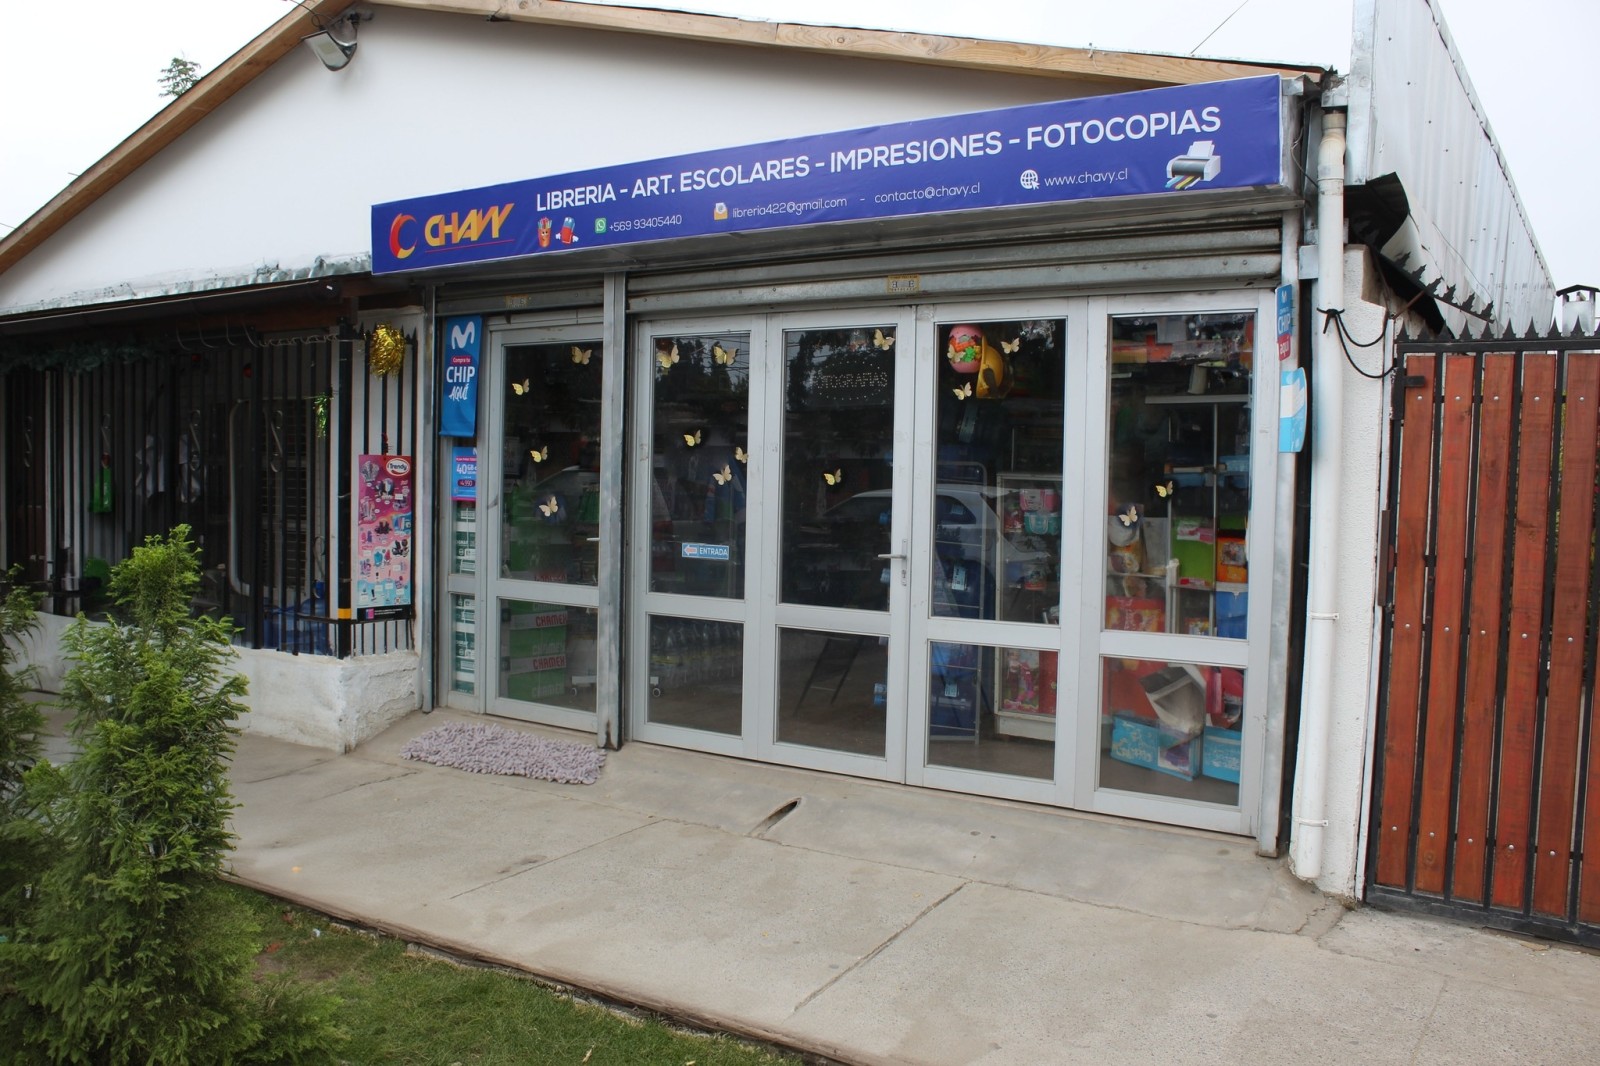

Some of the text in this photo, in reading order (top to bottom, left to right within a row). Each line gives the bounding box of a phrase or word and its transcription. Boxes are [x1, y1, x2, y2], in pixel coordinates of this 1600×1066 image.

[536, 183, 618, 213] LIBRERIA
[632, 174, 676, 199] ART.
[681, 155, 810, 192] ESCOLARES
[830, 131, 1003, 174] IMPRESIONES
[1027, 106, 1222, 151] FOTOCOPIAS
[1044, 168, 1128, 187] www.chavy.cl
[732, 198, 848, 218] libreria422@gmail.com
[874, 182, 981, 204] contacto@chavy.cl
[609, 214, 683, 233] +569 93405440
[1278, 314, 1291, 334] CHIP
[446, 366, 476, 383] CHIP
[456, 464, 467, 475] 40
[699, 546, 728, 556] ENTRADA
[535, 612, 567, 627] CHAMEX
[533, 655, 565, 670] CHAMEX
